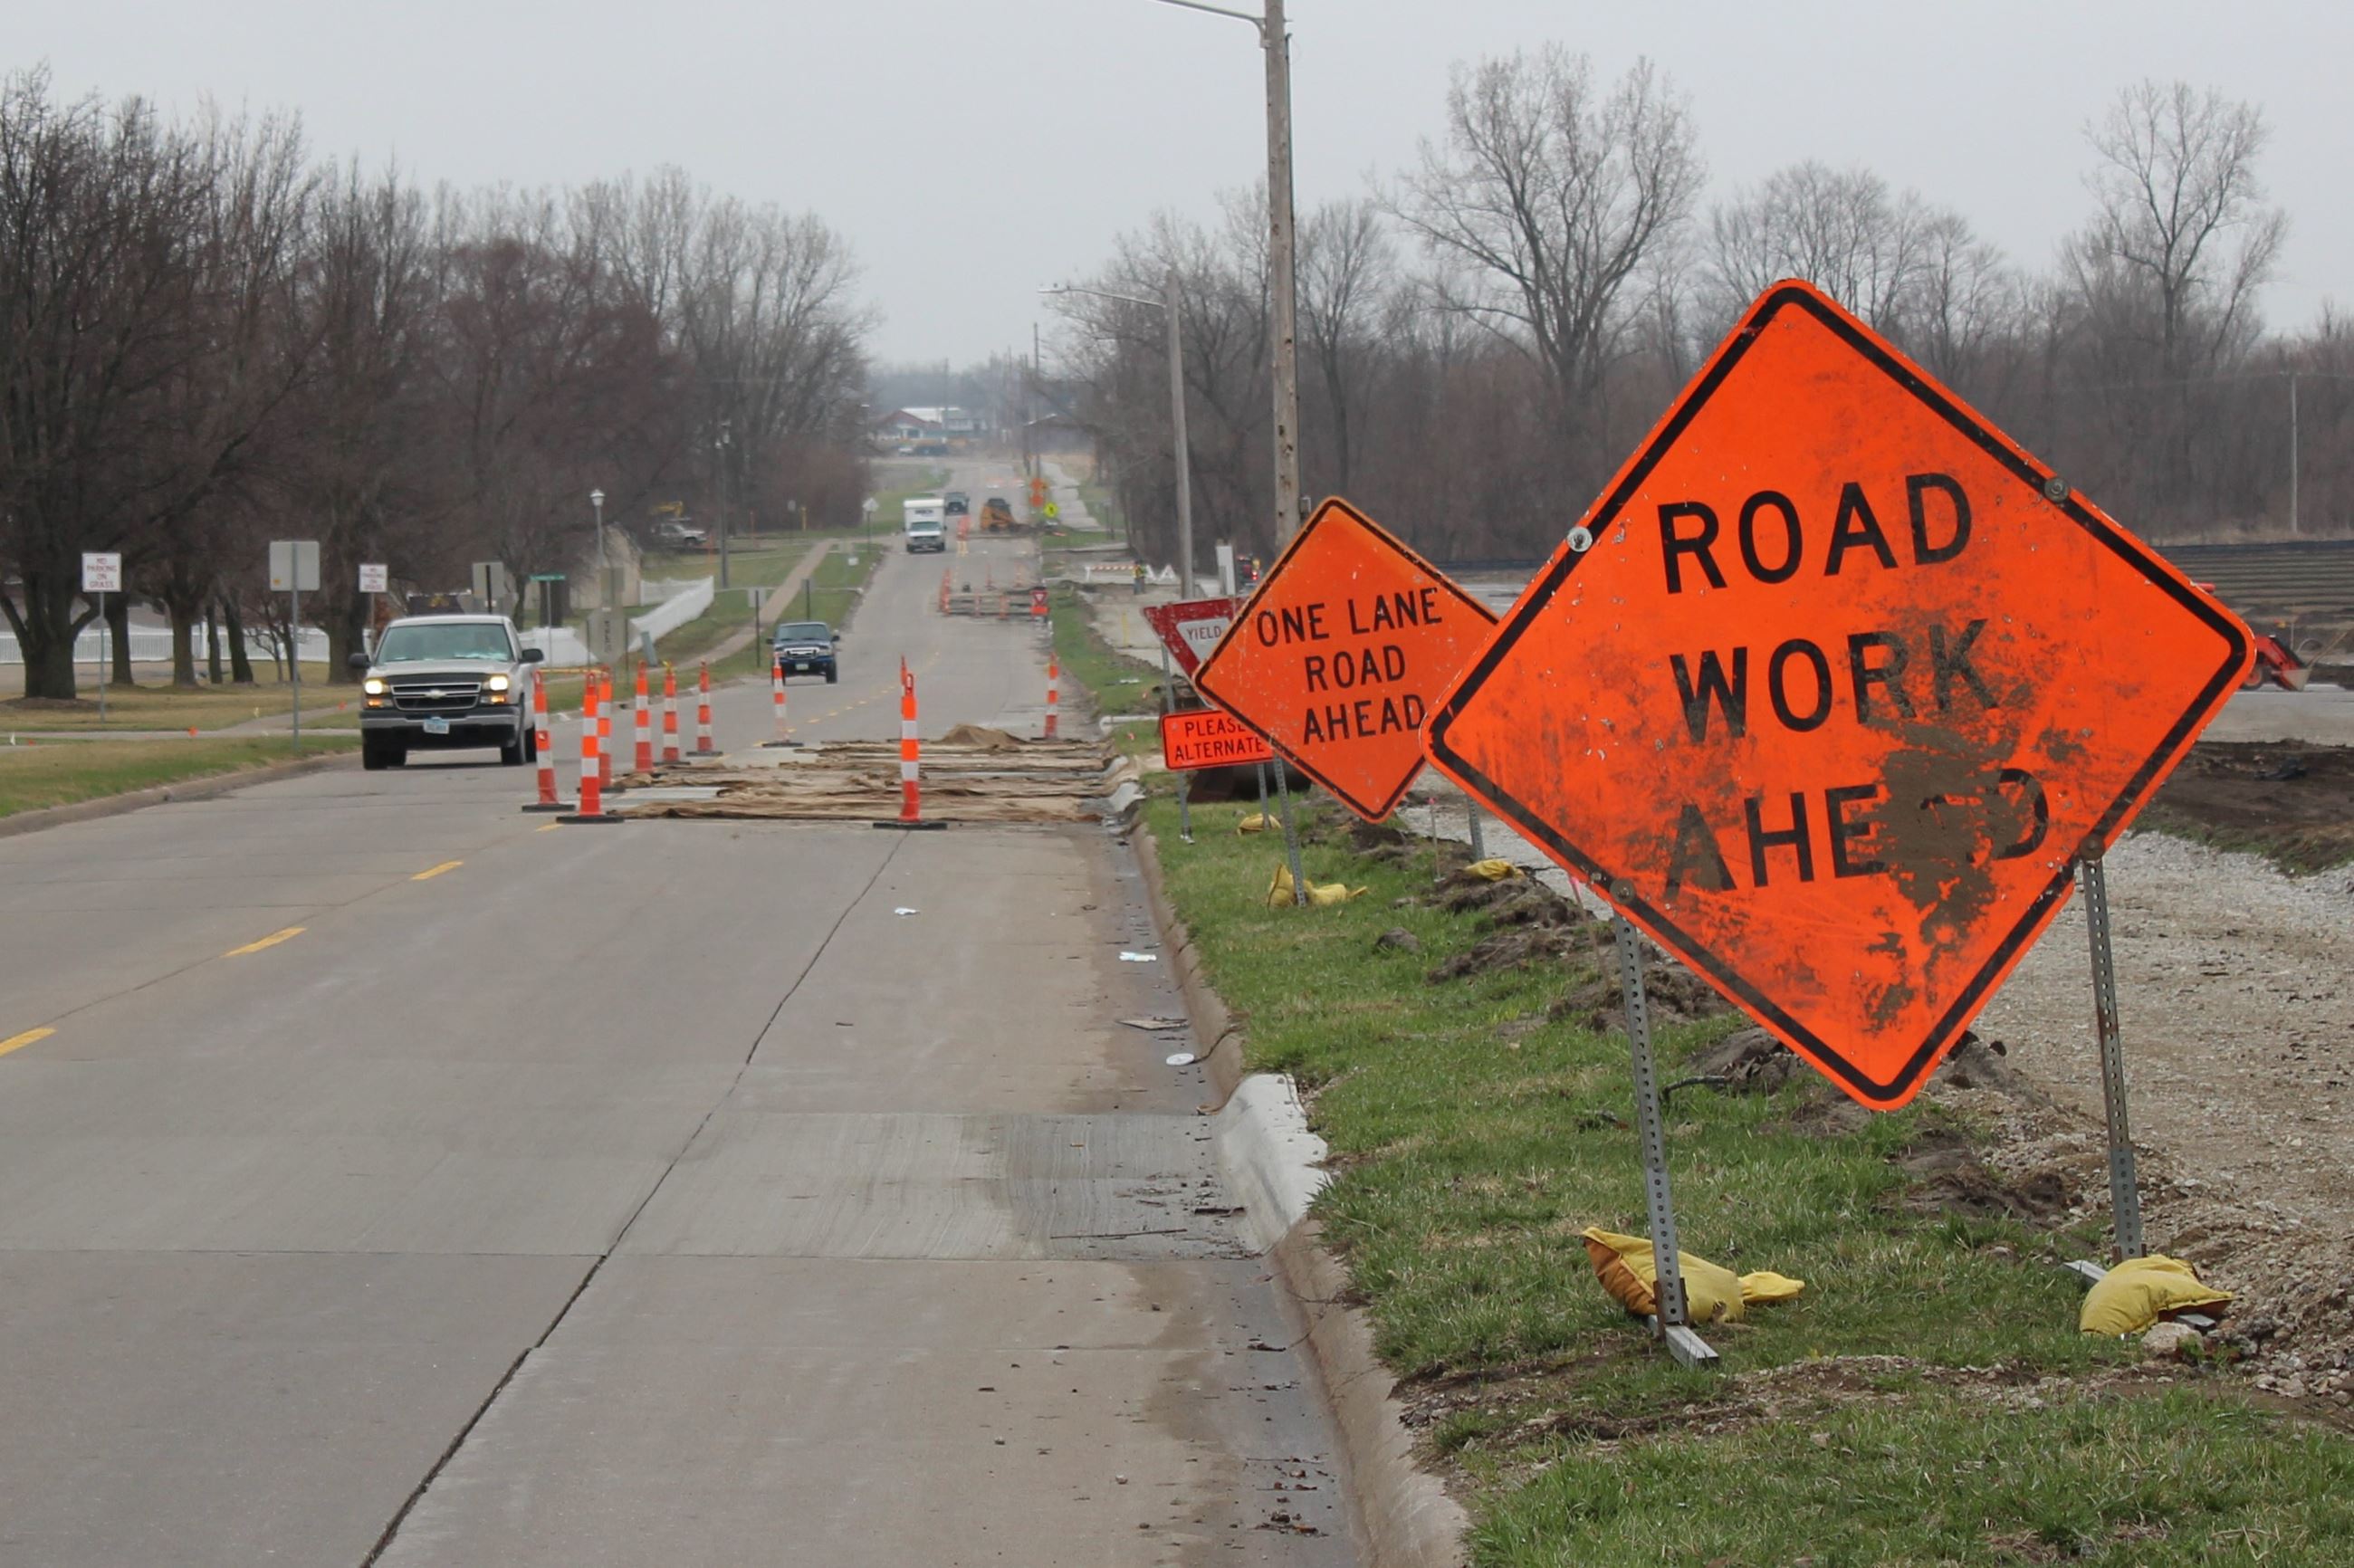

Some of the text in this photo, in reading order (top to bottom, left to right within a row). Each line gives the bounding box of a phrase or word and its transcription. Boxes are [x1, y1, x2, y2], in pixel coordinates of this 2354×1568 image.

[1657, 472, 1972, 594] ROAD
[1186, 626, 1222, 640] YIELD
[1257, 587, 1442, 647] ONE LANE
[1305, 645, 1406, 693] ROAD
[1669, 618, 1997, 742] WORK
[1303, 694, 1425, 745] AHEAD
[1174, 736, 1264, 760] ALTERNATE
[1663, 767, 2049, 903] AHED
